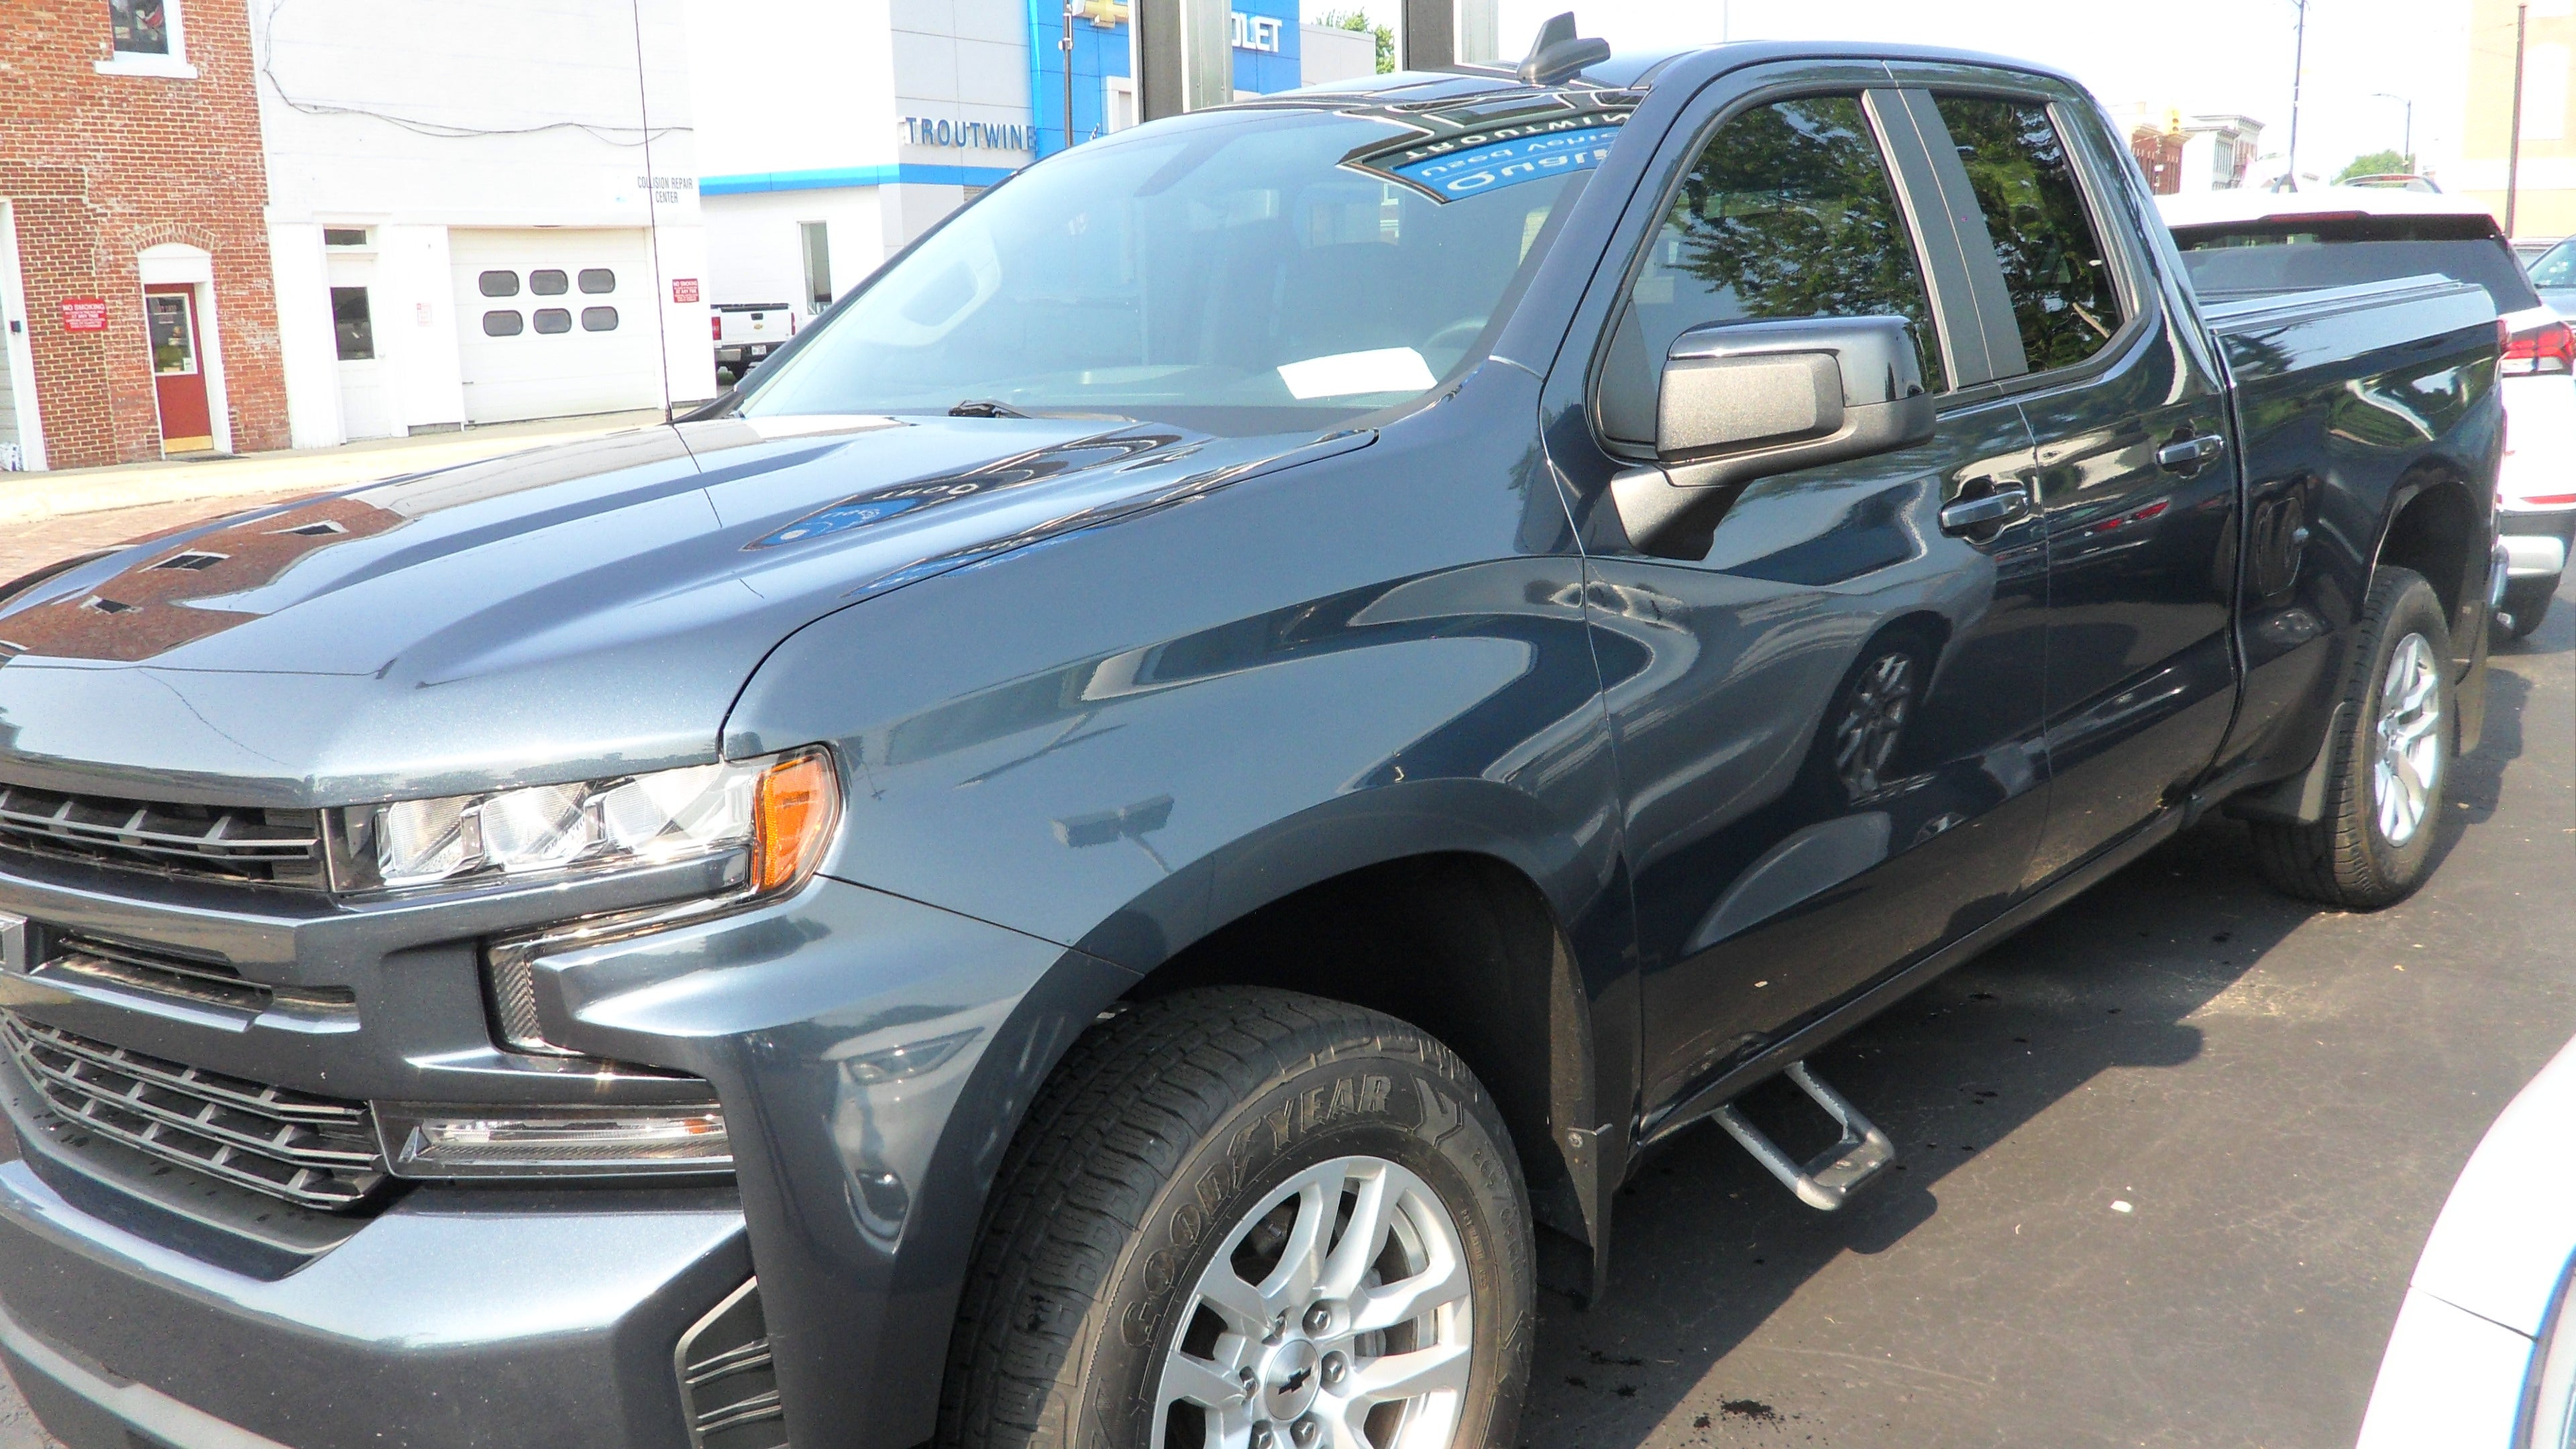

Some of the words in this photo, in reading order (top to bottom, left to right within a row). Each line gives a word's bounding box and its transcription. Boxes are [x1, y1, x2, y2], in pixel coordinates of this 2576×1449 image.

[903, 117, 1036, 151] TROUTWINE
[671, 177, 693, 189] REPAIR
[655, 191, 678, 203] CENTER
[74, 303, 105, 311] SMOKING
[1121, 1073, 1391, 1347] GOODYEAR
